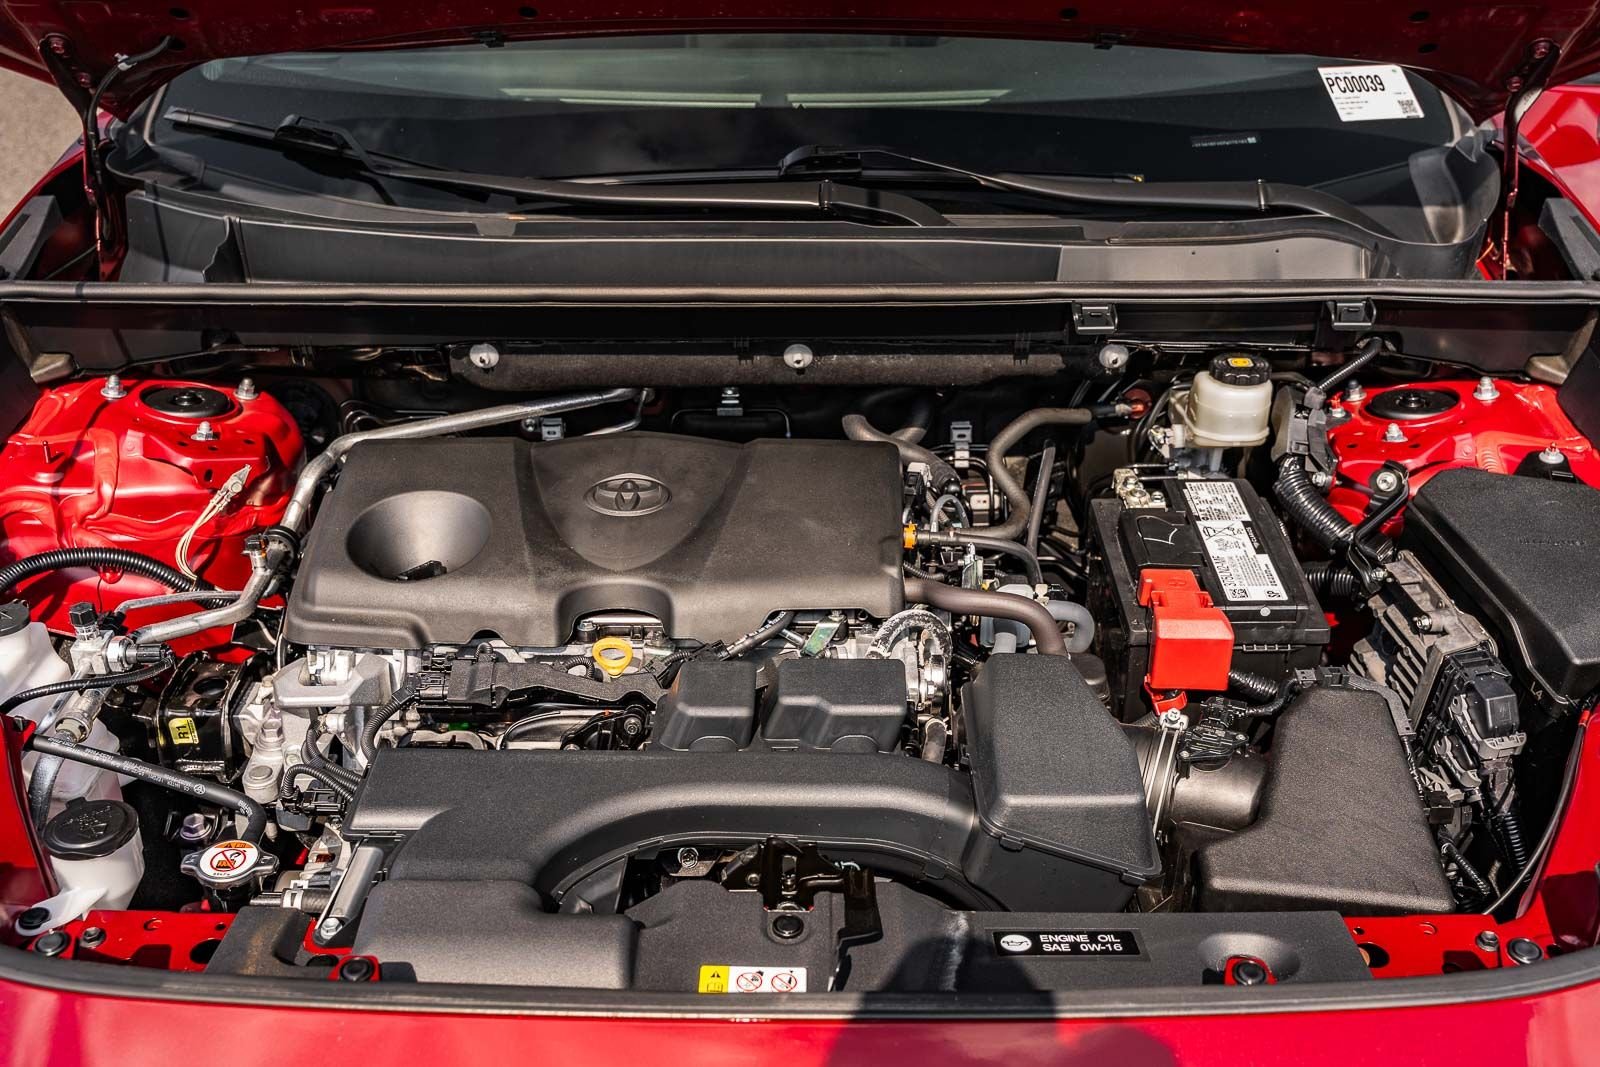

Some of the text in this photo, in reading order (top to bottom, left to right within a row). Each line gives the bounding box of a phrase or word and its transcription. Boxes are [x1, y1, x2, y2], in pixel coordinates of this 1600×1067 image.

[1325, 74, 1385, 94] PC00039
[1266, 590, 1281, 598] SP
[175, 724, 190, 739] R1
[1039, 934, 1121, 943] ENGINE OIL
[1042, 943, 1123, 952] SAE 0W-16
